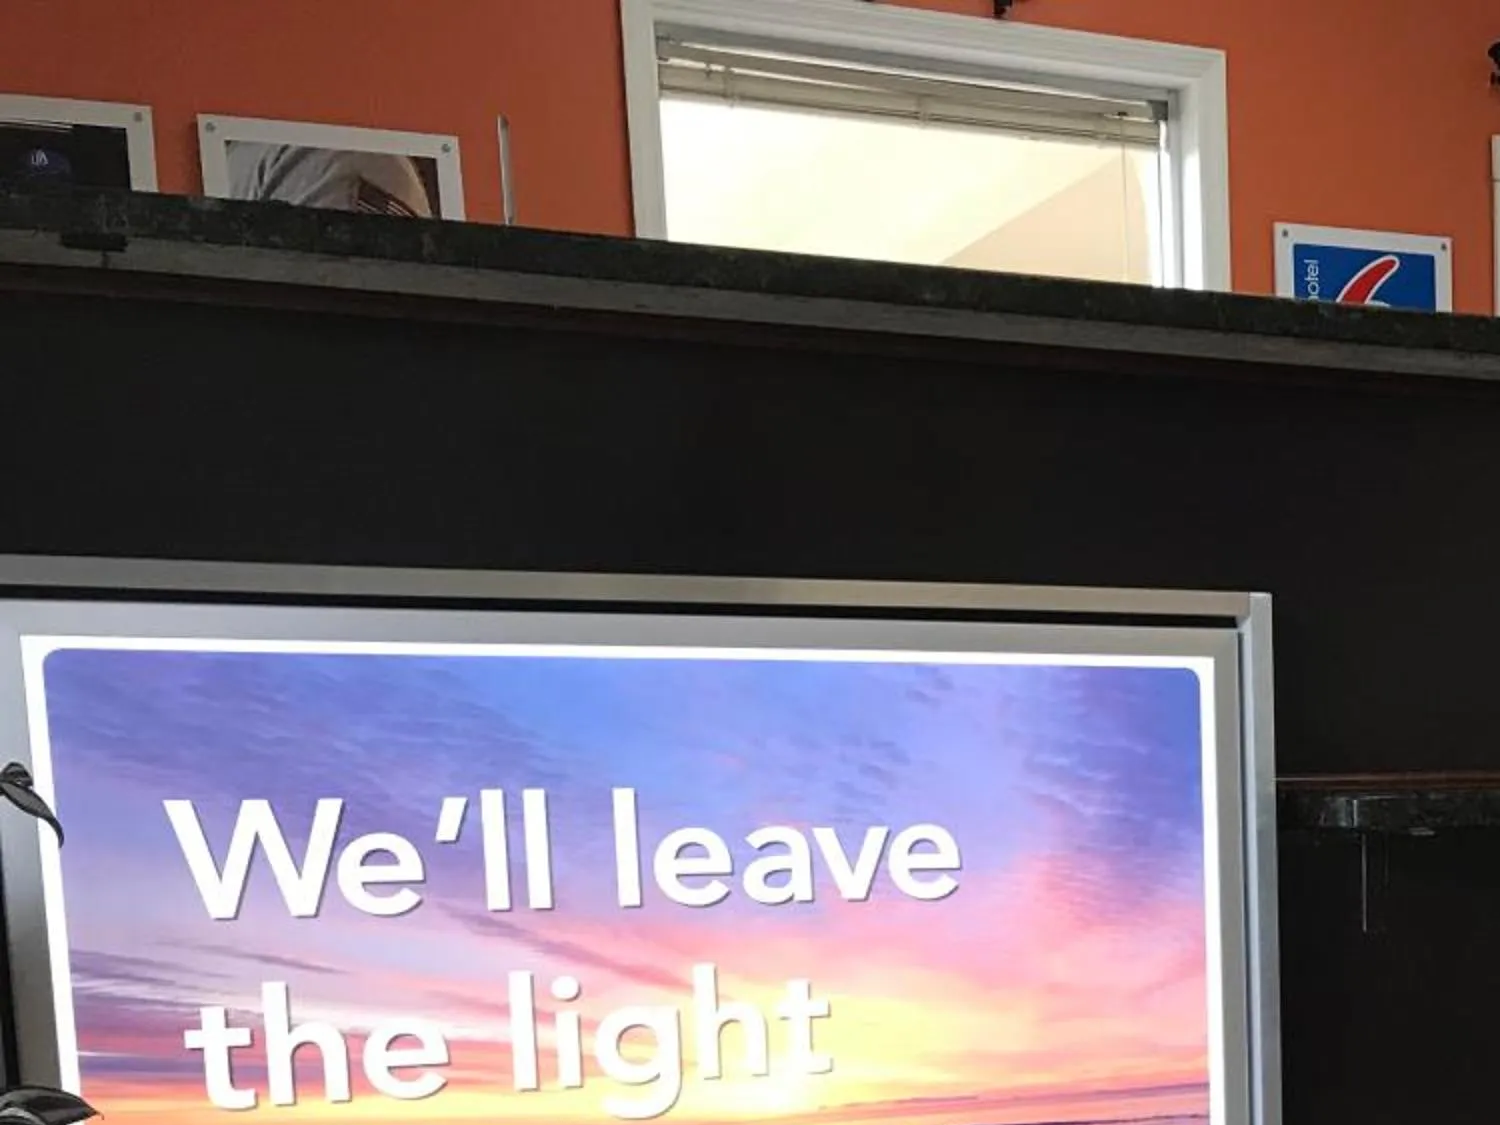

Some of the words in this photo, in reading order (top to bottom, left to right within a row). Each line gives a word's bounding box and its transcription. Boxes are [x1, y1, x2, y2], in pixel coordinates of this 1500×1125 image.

[164, 788, 556, 920] We'll
[612, 788, 962, 907] leave
[185, 981, 450, 1111] the
[508, 963, 834, 1120] light
